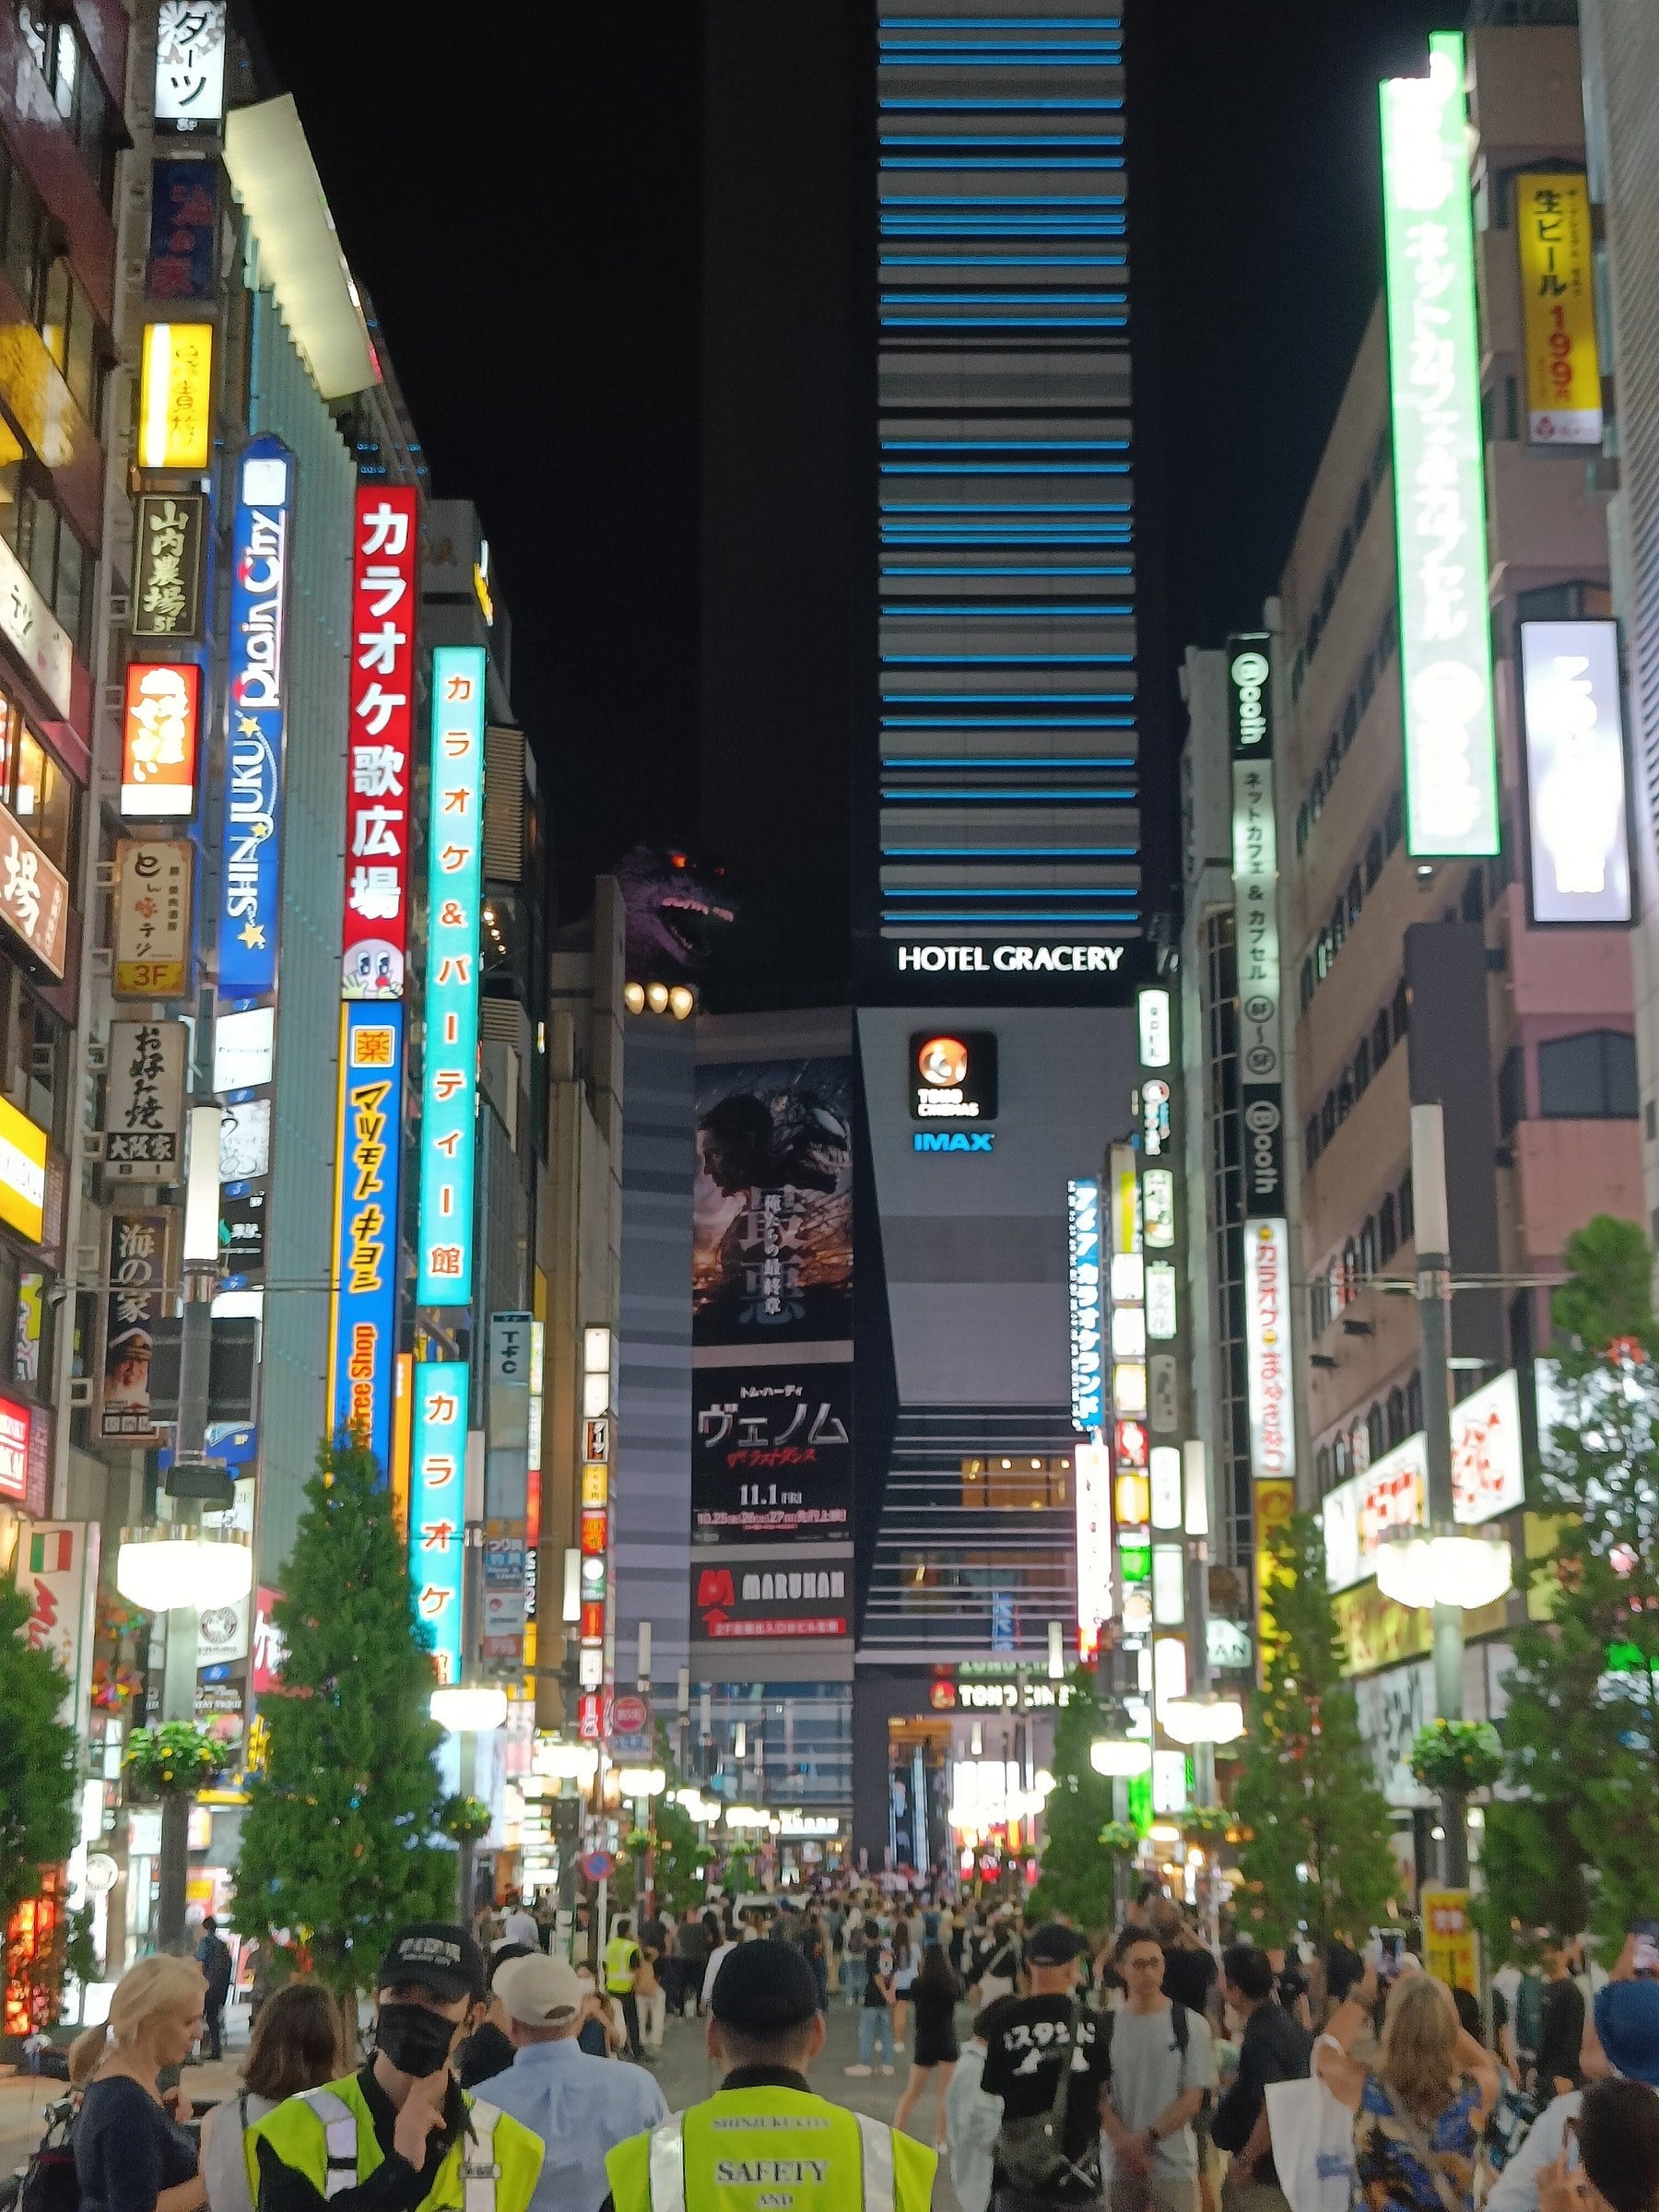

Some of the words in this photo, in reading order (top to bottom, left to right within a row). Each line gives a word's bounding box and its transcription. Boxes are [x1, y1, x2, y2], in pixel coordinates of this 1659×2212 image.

[1534, 190, 1567, 296] 生ビール
[143, 502, 188, 616] 山内農場
[153, 617, 177, 632] 5F
[347, 502, 408, 921] カラオケ歌広場
[227, 738, 273, 917] SHINJUKU
[134, 965, 170, 986] 3F
[430, 676, 473, 1276] カラオケ&パーティー館
[899, 946, 990, 971] HOTEL
[993, 946, 1124, 971] GRACERY
[356, 1030, 390, 1063] 薬
[913, 1132, 994, 1152] IMAX
[1245, 1100, 1281, 1194] Booth
[349, 1081, 393, 1294] マツモトキヨシ
[116, 1224, 155, 1324] 海の家
[350, 1324, 377, 1381] Shop
[698, 1402, 850, 1448] ヴェノム
[740, 1484, 777, 1506] 11.1
[742, 1571, 845, 1600] MARUHAN
[716, 2159, 829, 2183] SAFETY
[758, 2194, 794, 2206] AND
